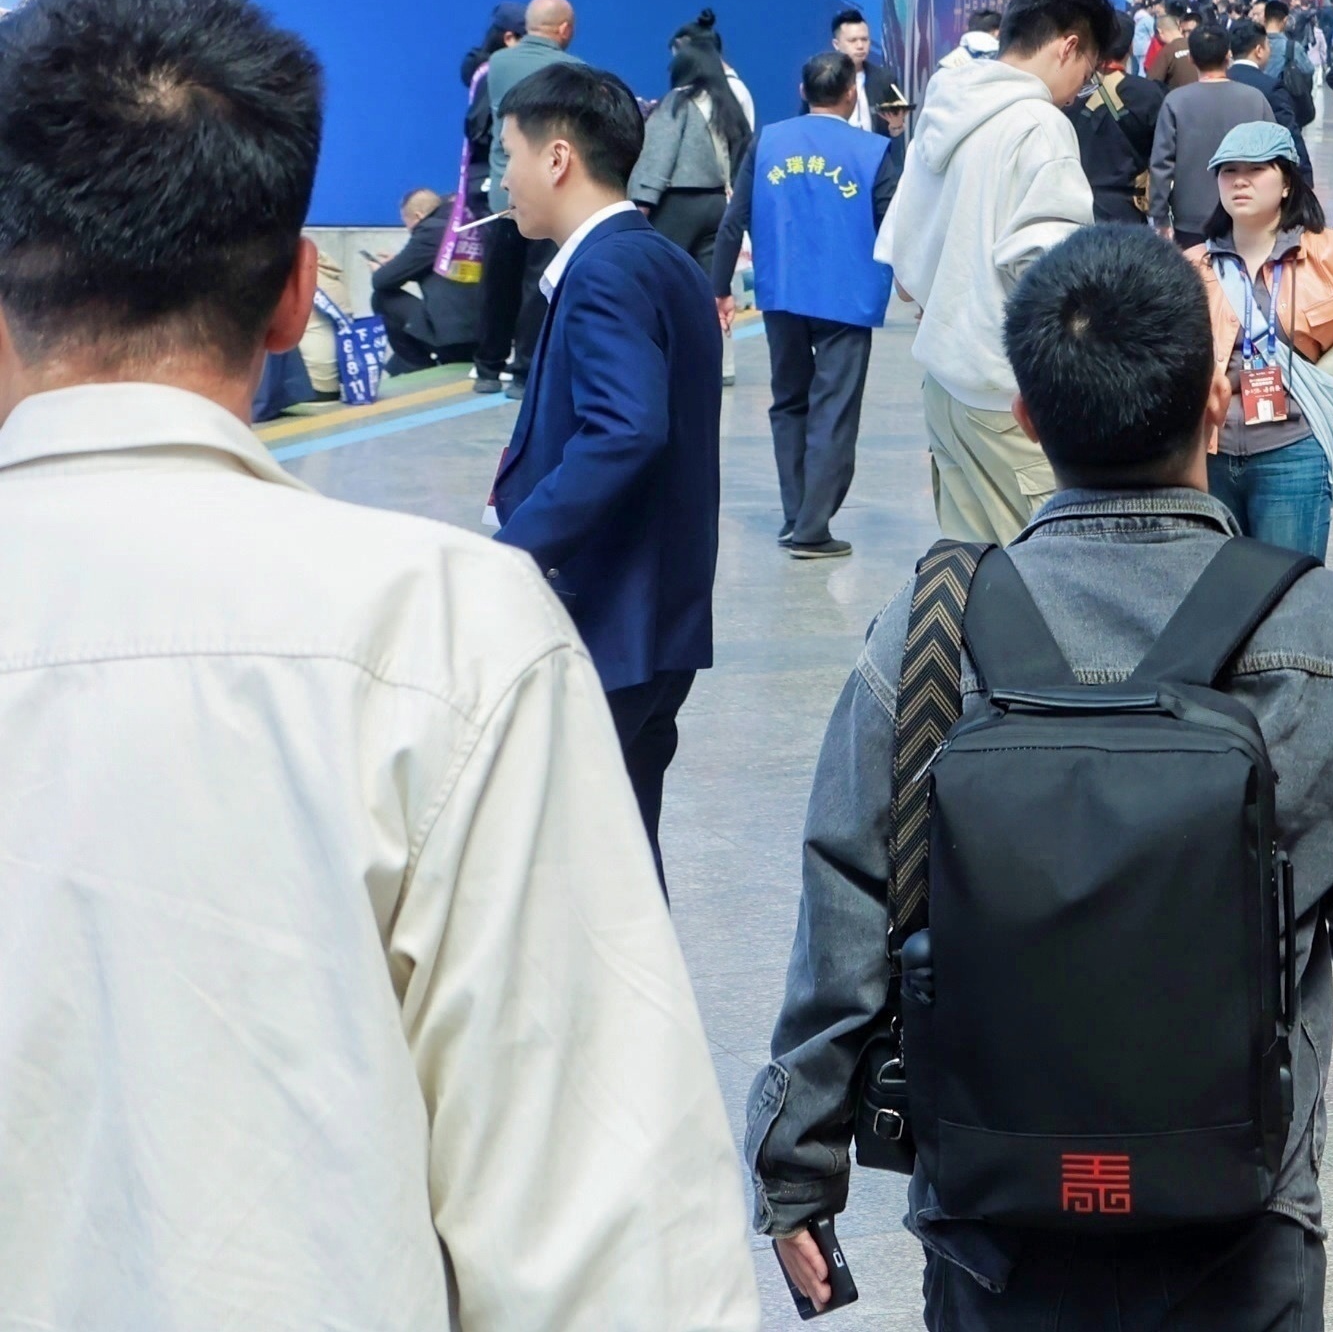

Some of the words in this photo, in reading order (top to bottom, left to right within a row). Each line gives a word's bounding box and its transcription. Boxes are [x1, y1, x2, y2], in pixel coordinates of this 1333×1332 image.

[766, 154, 858, 200] 科瑞特人力
